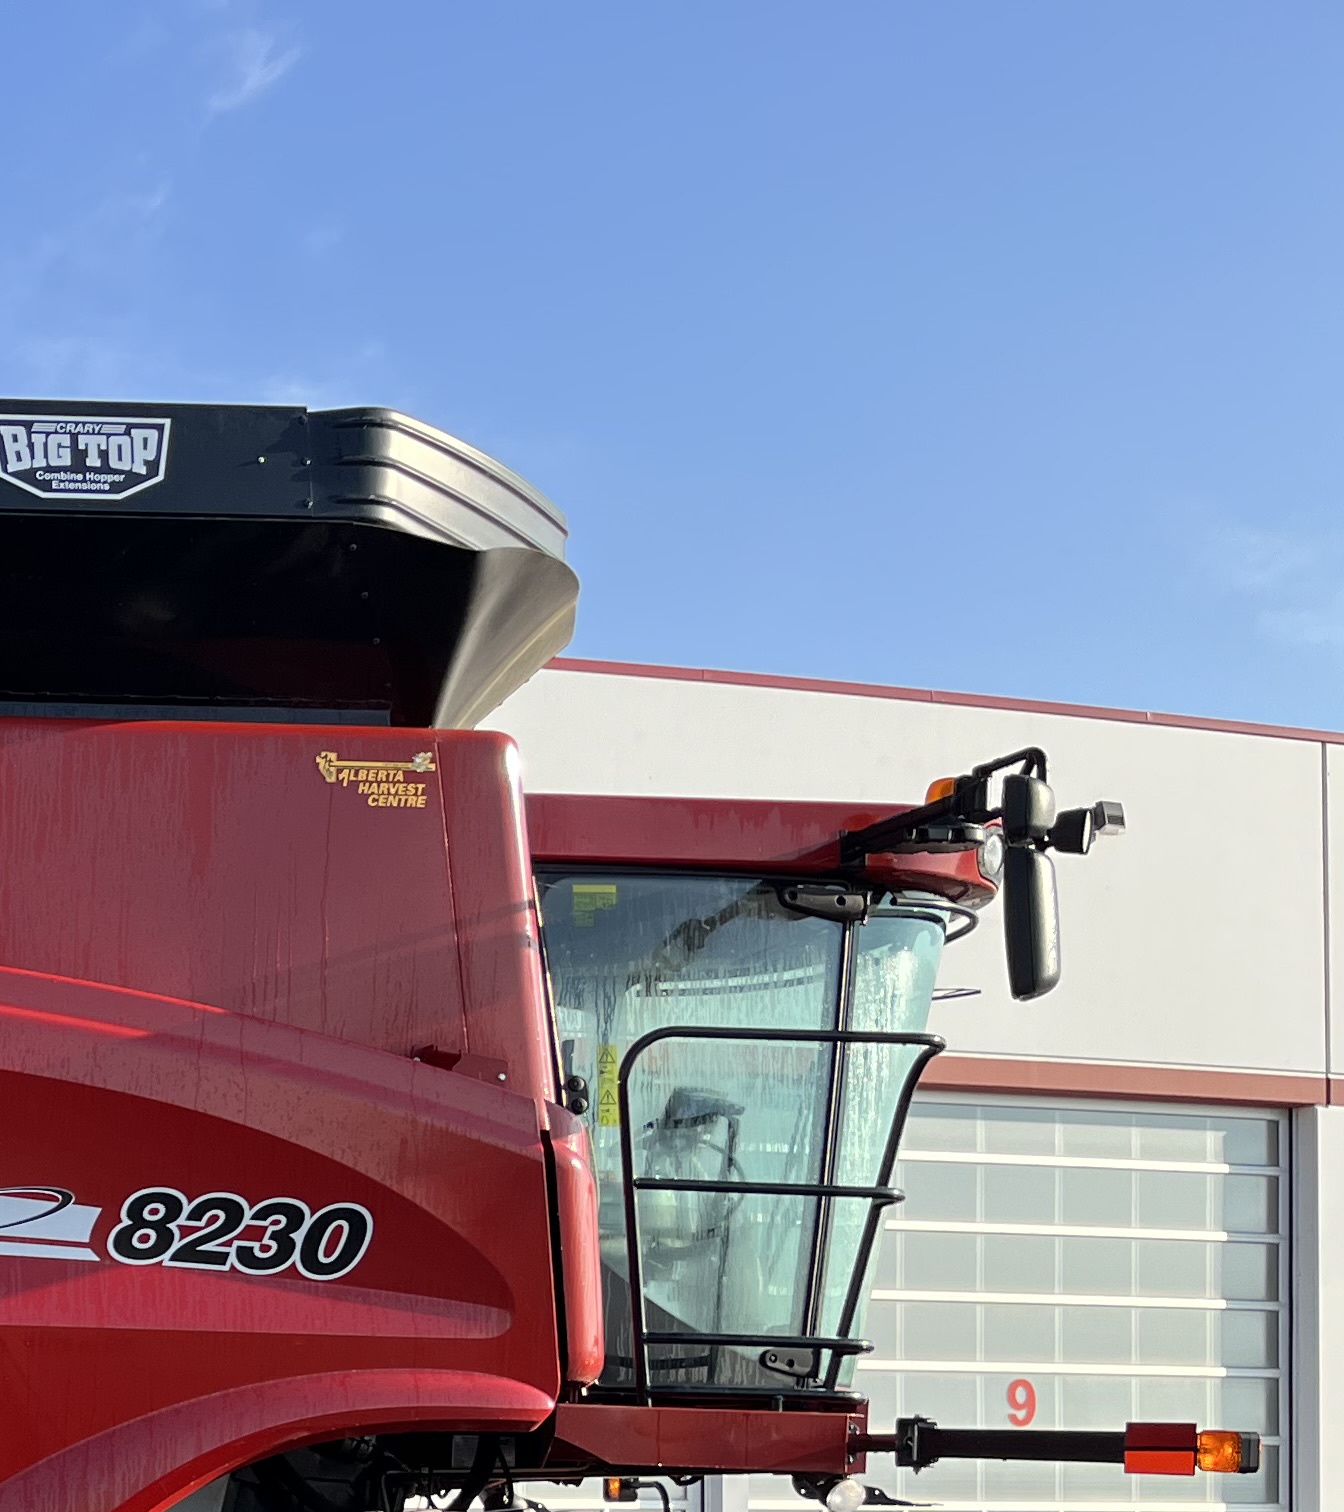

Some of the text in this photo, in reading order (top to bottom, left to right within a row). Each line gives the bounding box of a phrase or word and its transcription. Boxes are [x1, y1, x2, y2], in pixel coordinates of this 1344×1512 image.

[57, 421, 102, 434] CRARY
[0, 425, 159, 475] BIG TOP
[35, 470, 126, 483] Combine Hopper
[51, 480, 111, 491] Extensions
[338, 768, 404, 787] ALBERTA
[358, 783, 426, 796] HARVEST
[367, 795, 427, 808] CENTRE
[106, 1186, 374, 1281] 8230
[1007, 1378, 1037, 1427] 9
